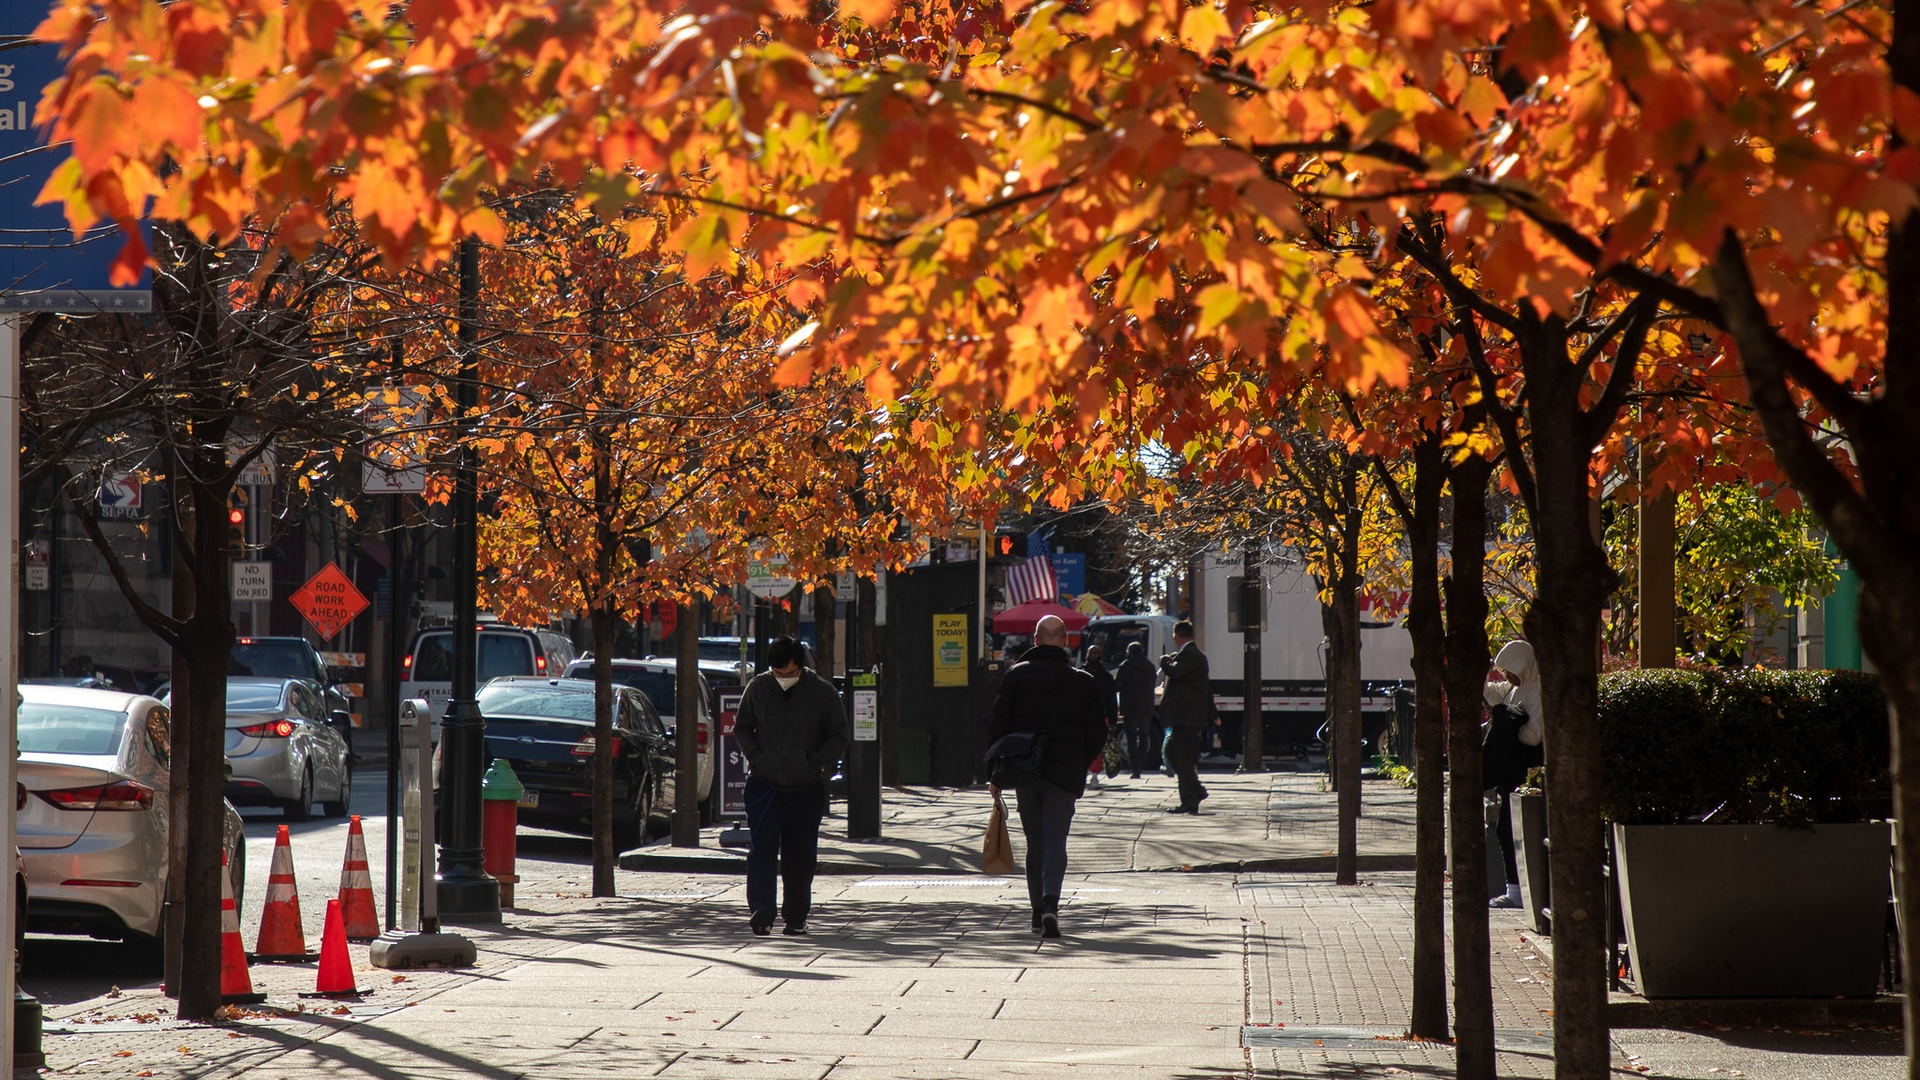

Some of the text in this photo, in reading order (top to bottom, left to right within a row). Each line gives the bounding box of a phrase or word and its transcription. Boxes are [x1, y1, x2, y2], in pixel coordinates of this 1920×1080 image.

[245, 566, 260, 575] NO
[240, 577, 265, 586] TURN
[315, 582, 345, 593] ROAD
[236, 588, 268, 598] ON RED
[314, 595, 344, 606] WORK
[310, 607, 347, 619] AHEAD
[939, 620, 962, 628] PLAY
[935, 629, 967, 637] TODAY!
[871, 664, 880, 675] A
